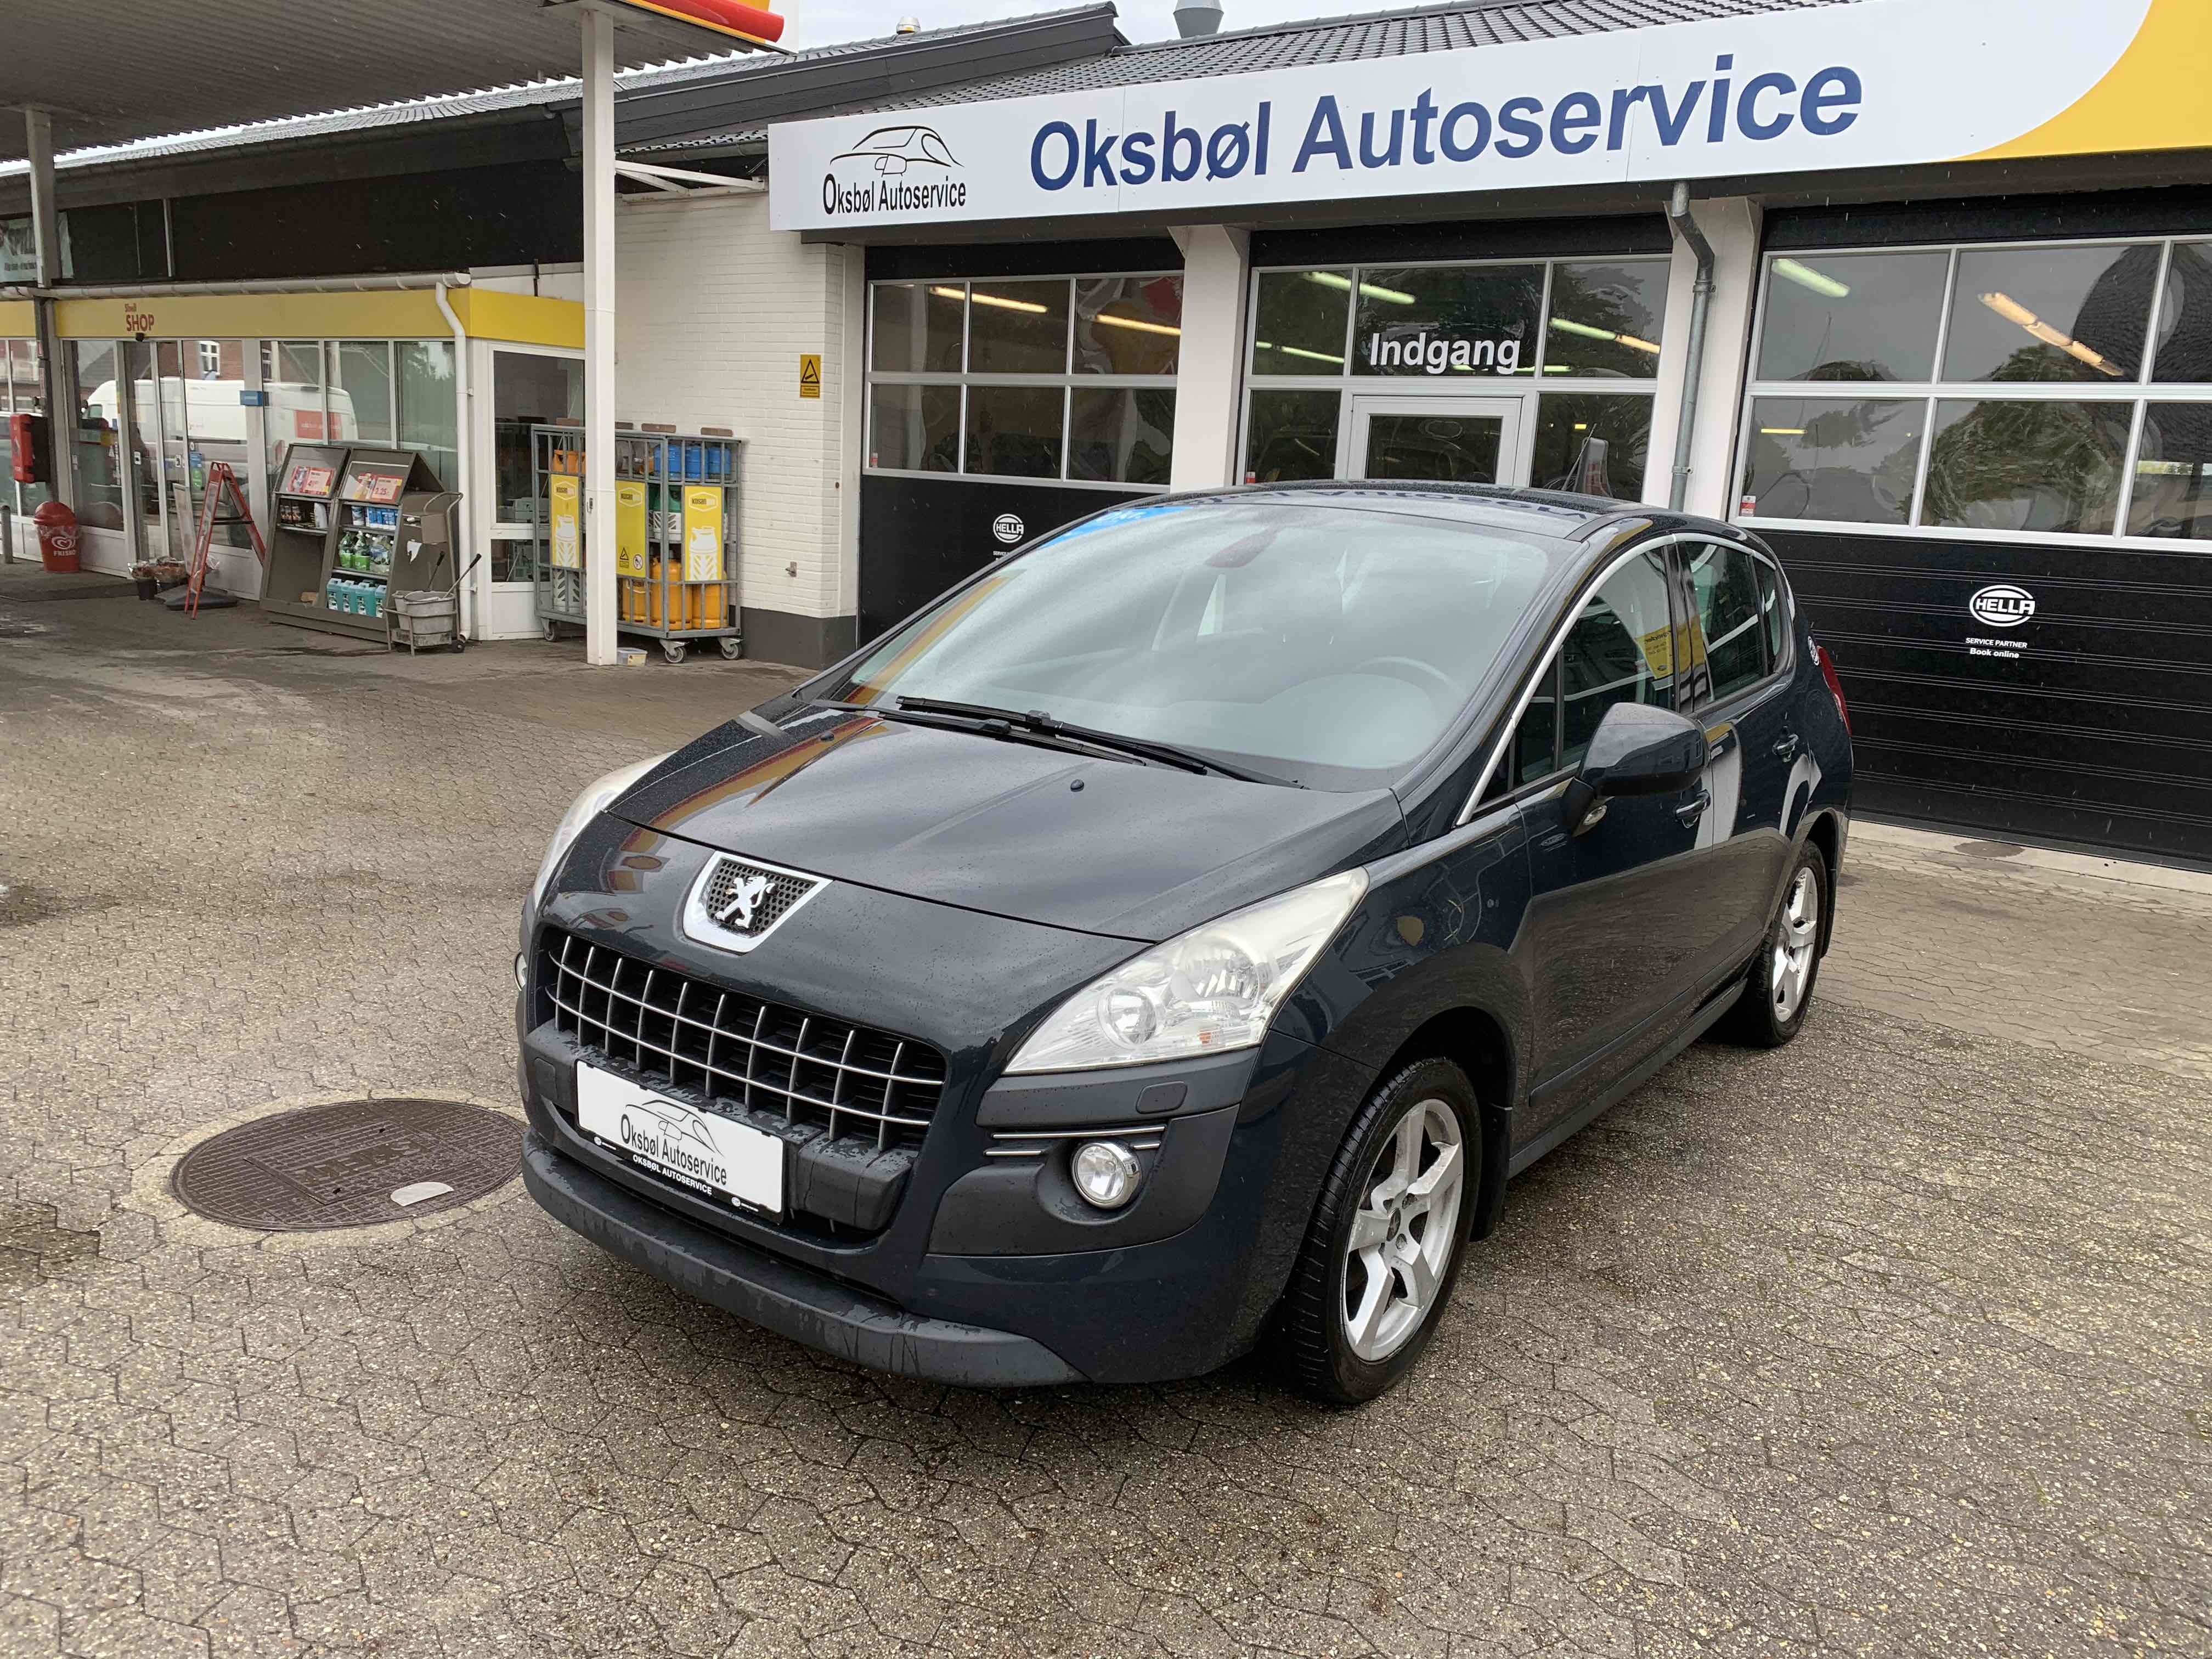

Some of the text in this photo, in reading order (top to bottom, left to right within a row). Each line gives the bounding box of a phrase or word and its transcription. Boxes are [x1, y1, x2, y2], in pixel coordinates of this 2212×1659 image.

[1030, 55, 1862, 190] Oksbøl Autoservice
[823, 173, 966, 215] Oksbøl Autoservice
[126, 314, 155, 332] SHOP
[1370, 332, 1521, 375] Indgang
[996, 523, 1024, 534] HELLA
[1976, 598, 2035, 615] HELLA
[1966, 637, 2028, 648] SERVICE PARTNER
[1970, 647, 2019, 658] Book online
[620, 1114, 727, 1186] Oksbøl Autoservice
[633, 1154, 713, 1195] OKSBØL AUTOSERVICE
